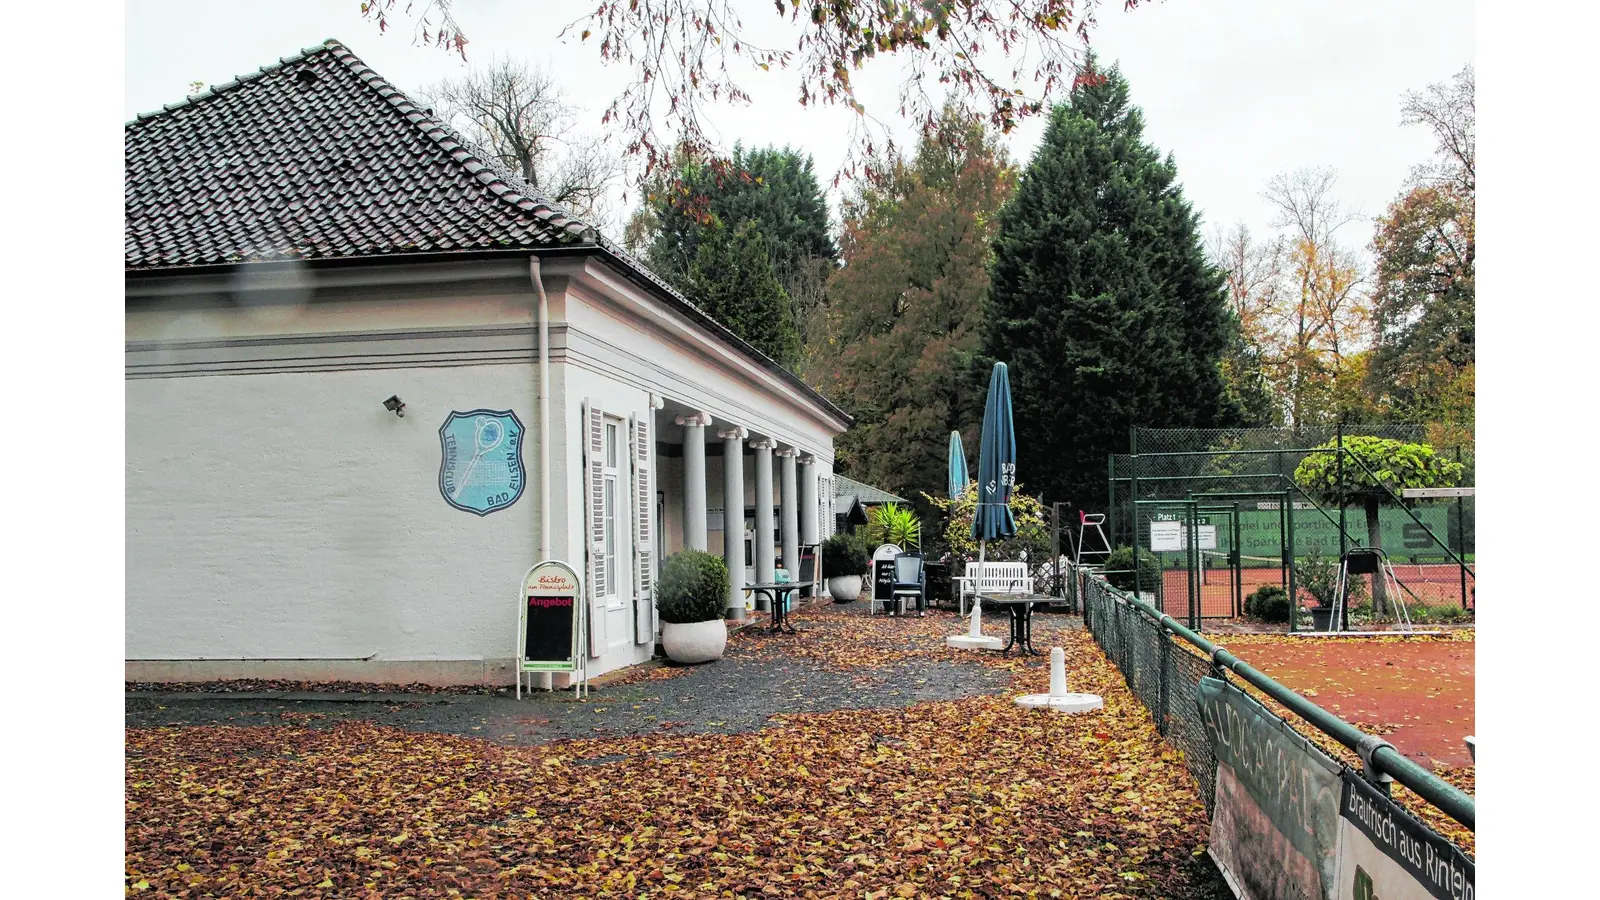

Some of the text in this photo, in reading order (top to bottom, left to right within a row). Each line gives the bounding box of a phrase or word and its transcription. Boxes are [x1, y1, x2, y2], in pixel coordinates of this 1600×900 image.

[487, 492, 509, 506] BAD
[507, 452, 519, 491] EILSEN
[1158, 513, 1172, 521] Platz
[538, 575, 567, 584] Bistro
[529, 596, 573, 608] Angebot
[1348, 782, 1397, 850] Braufrisch
[1400, 830, 1422, 869] aus
